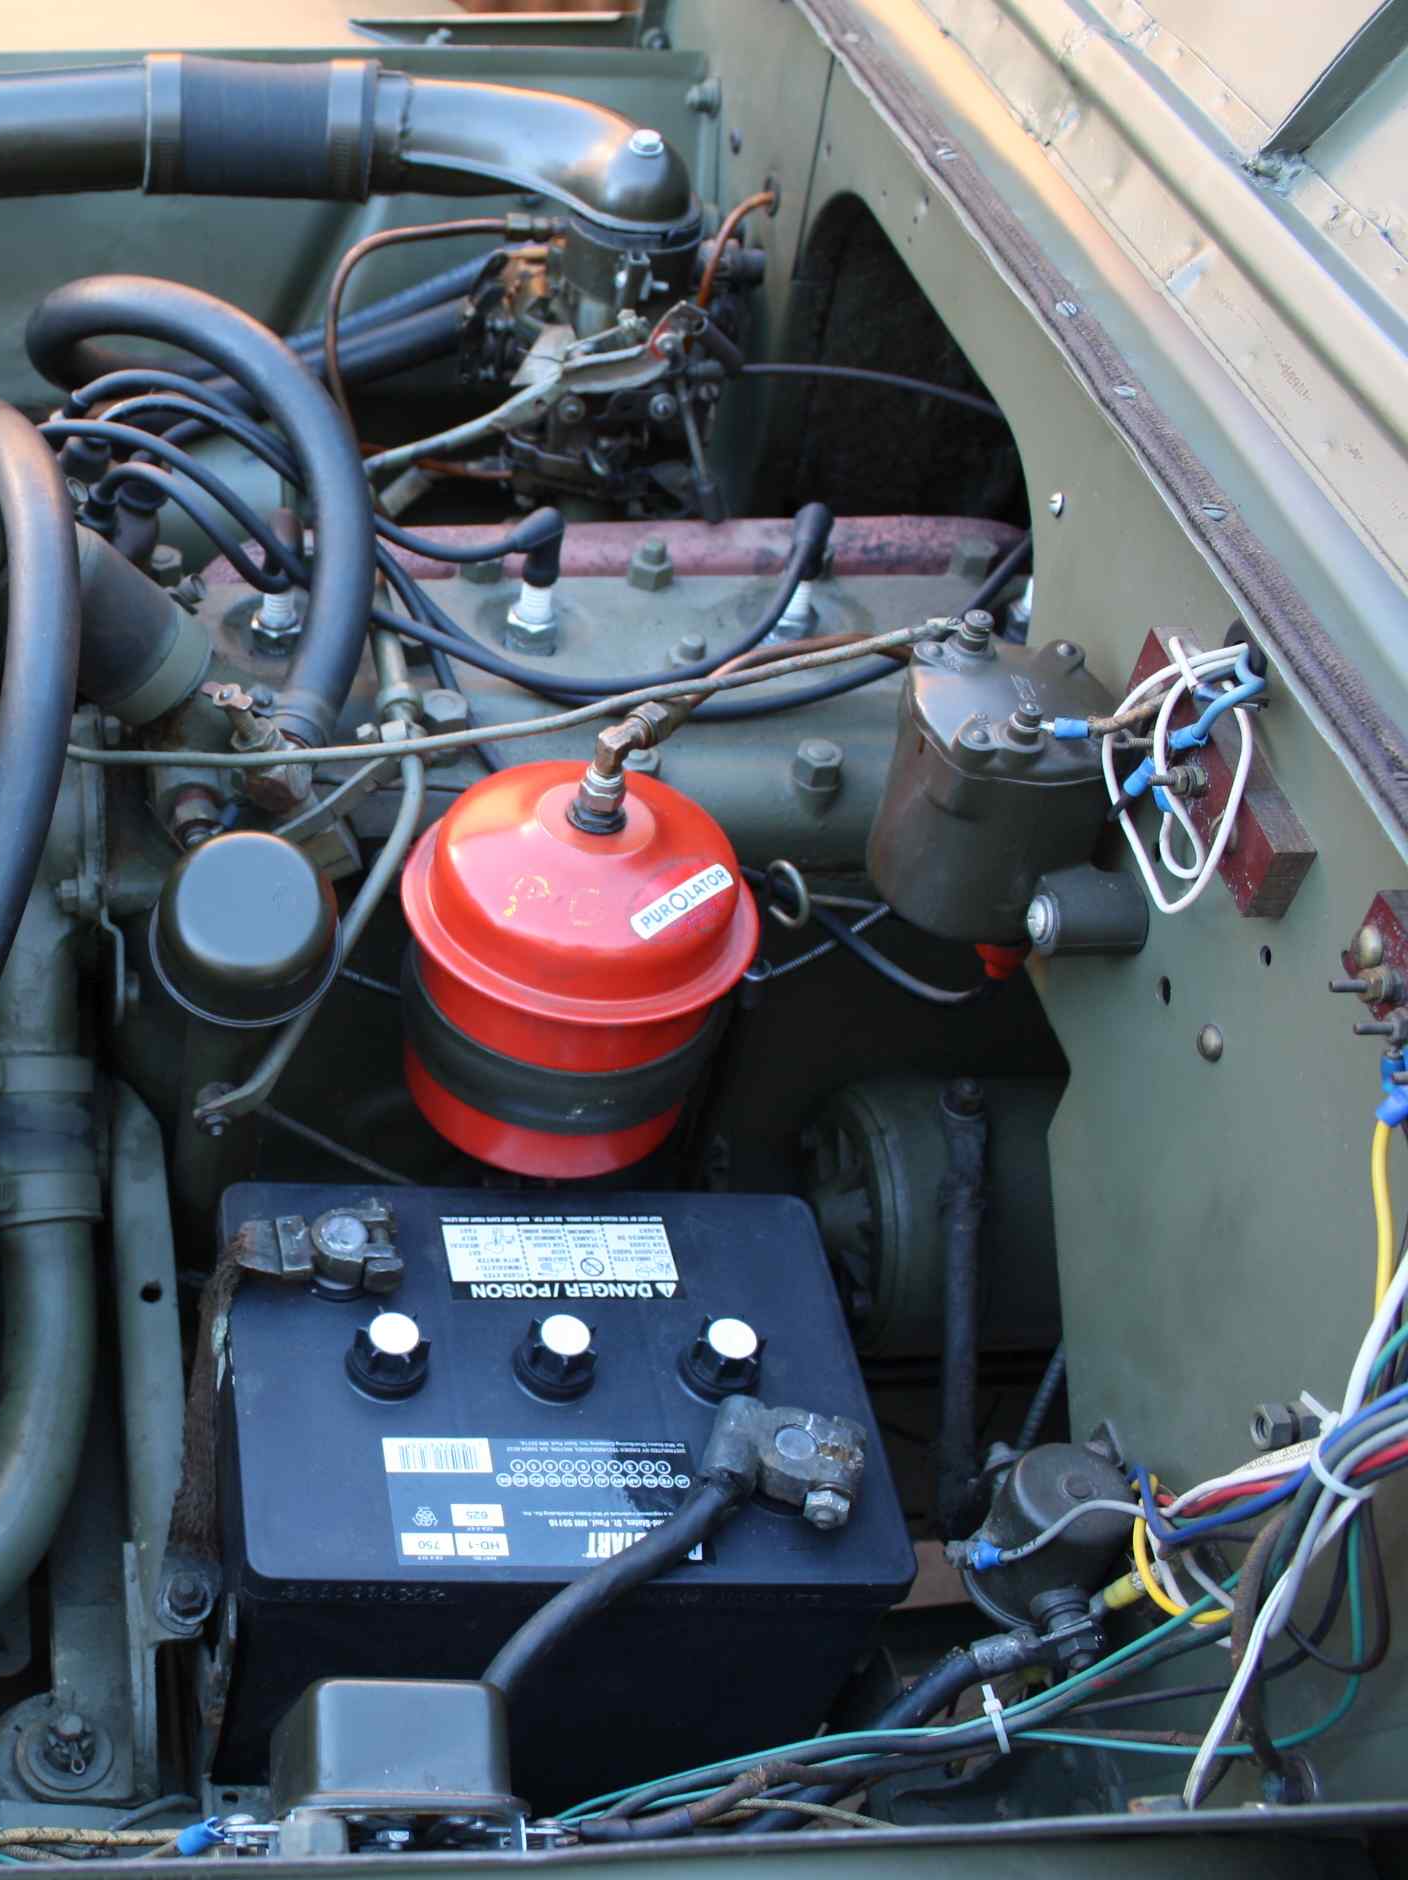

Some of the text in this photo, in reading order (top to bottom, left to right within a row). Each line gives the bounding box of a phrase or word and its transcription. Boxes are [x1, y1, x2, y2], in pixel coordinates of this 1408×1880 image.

[640, 870, 729, 929] PUROLATOR
[564, 1283, 653, 1298] DANGER
[466, 1510, 488, 1520] 625
[418, 1540, 440, 1550] 750
[468, 1540, 500, 1550] HD-1
